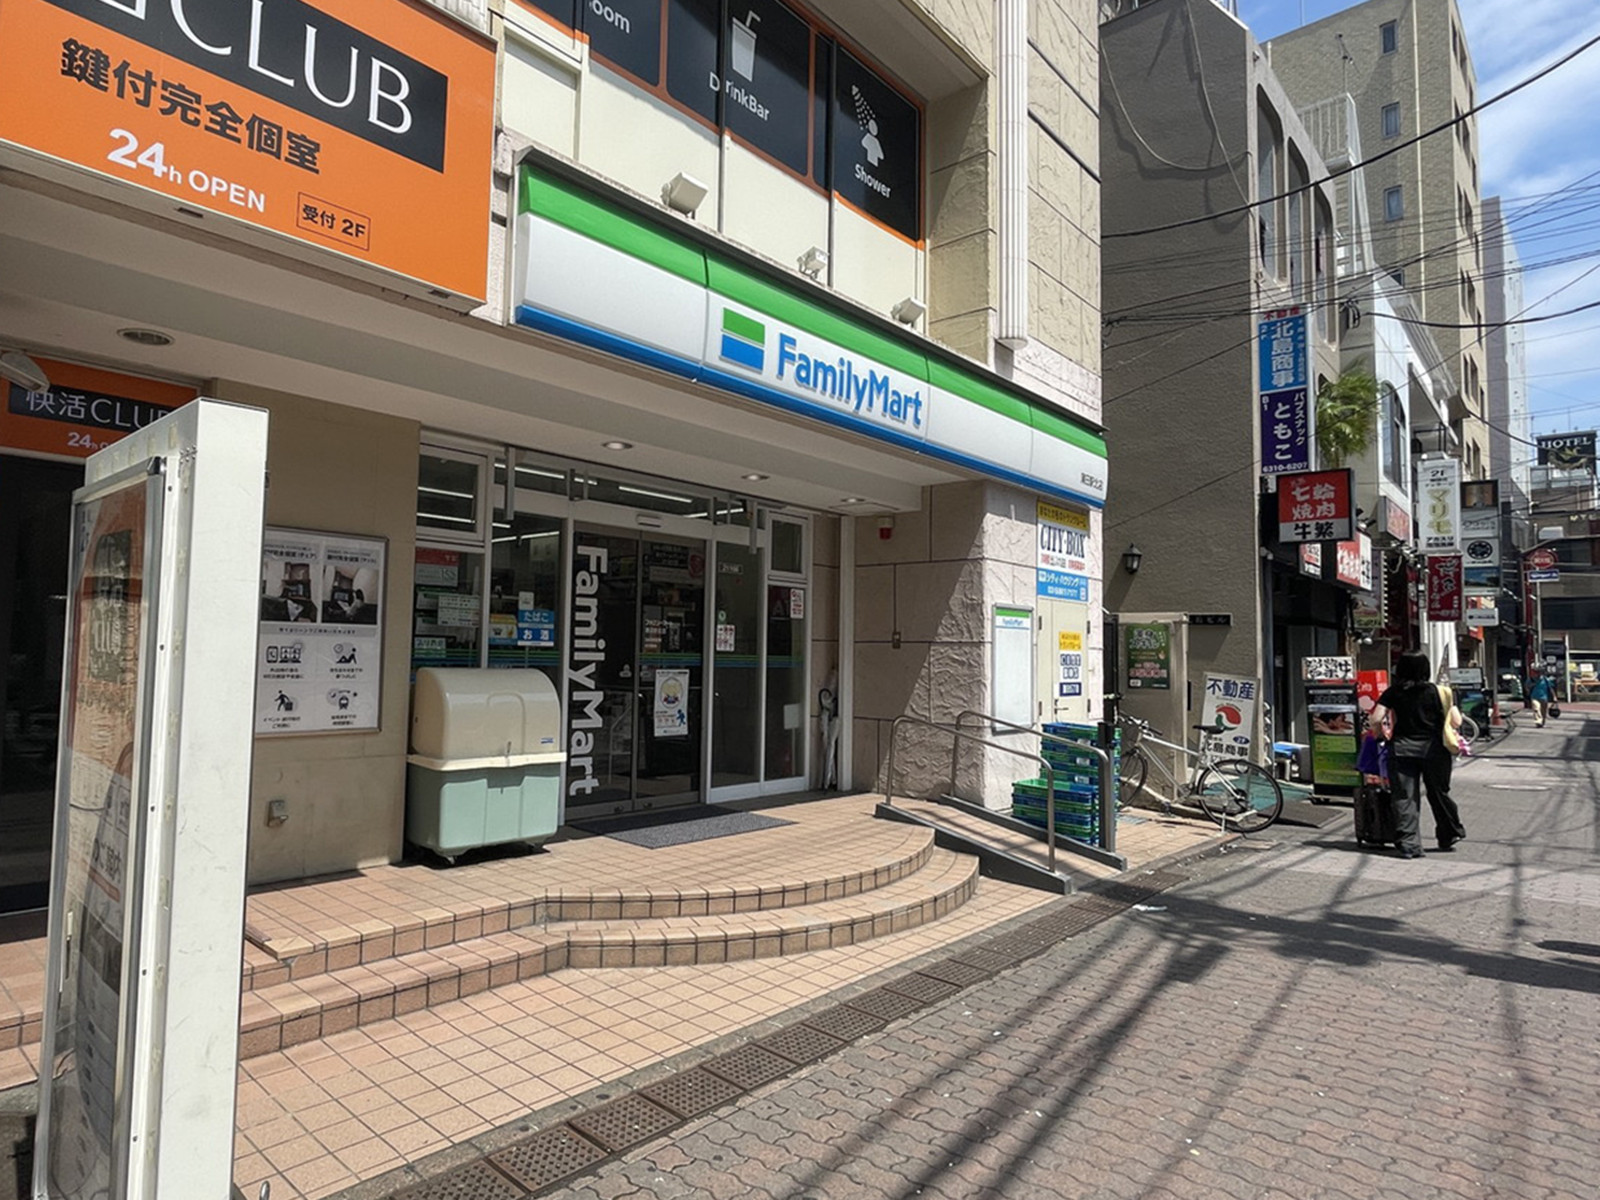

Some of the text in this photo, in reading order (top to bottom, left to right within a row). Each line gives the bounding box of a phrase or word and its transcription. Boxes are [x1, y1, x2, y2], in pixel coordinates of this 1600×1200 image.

[589, 0, 631, 34] oom
[96, 0, 413, 135] CLUB
[60, 37, 321, 175] 鍵付完全個室
[709, 71, 770, 121] DrinkBar
[106, 127, 265, 213] 24h OPEN
[854, 163, 892, 199] Shower
[301, 203, 367, 239] 受付 2F
[1271, 320, 1294, 387] 北島商事
[777, 332, 923, 427] FamilyMart
[1273, 401, 1293, 461] ともこ
[1540, 436, 1592, 449] HOTEL
[1291, 483, 1336, 502] 七輪
[1291, 502, 1336, 520] 焼肉
[1427, 487, 1452, 534] マリモ
[1294, 521, 1335, 540] 牛繁
[523, 611, 549, 622] たばこ
[567, 544, 608, 796] FamilyMart
[1206, 677, 1255, 700] 不動産
